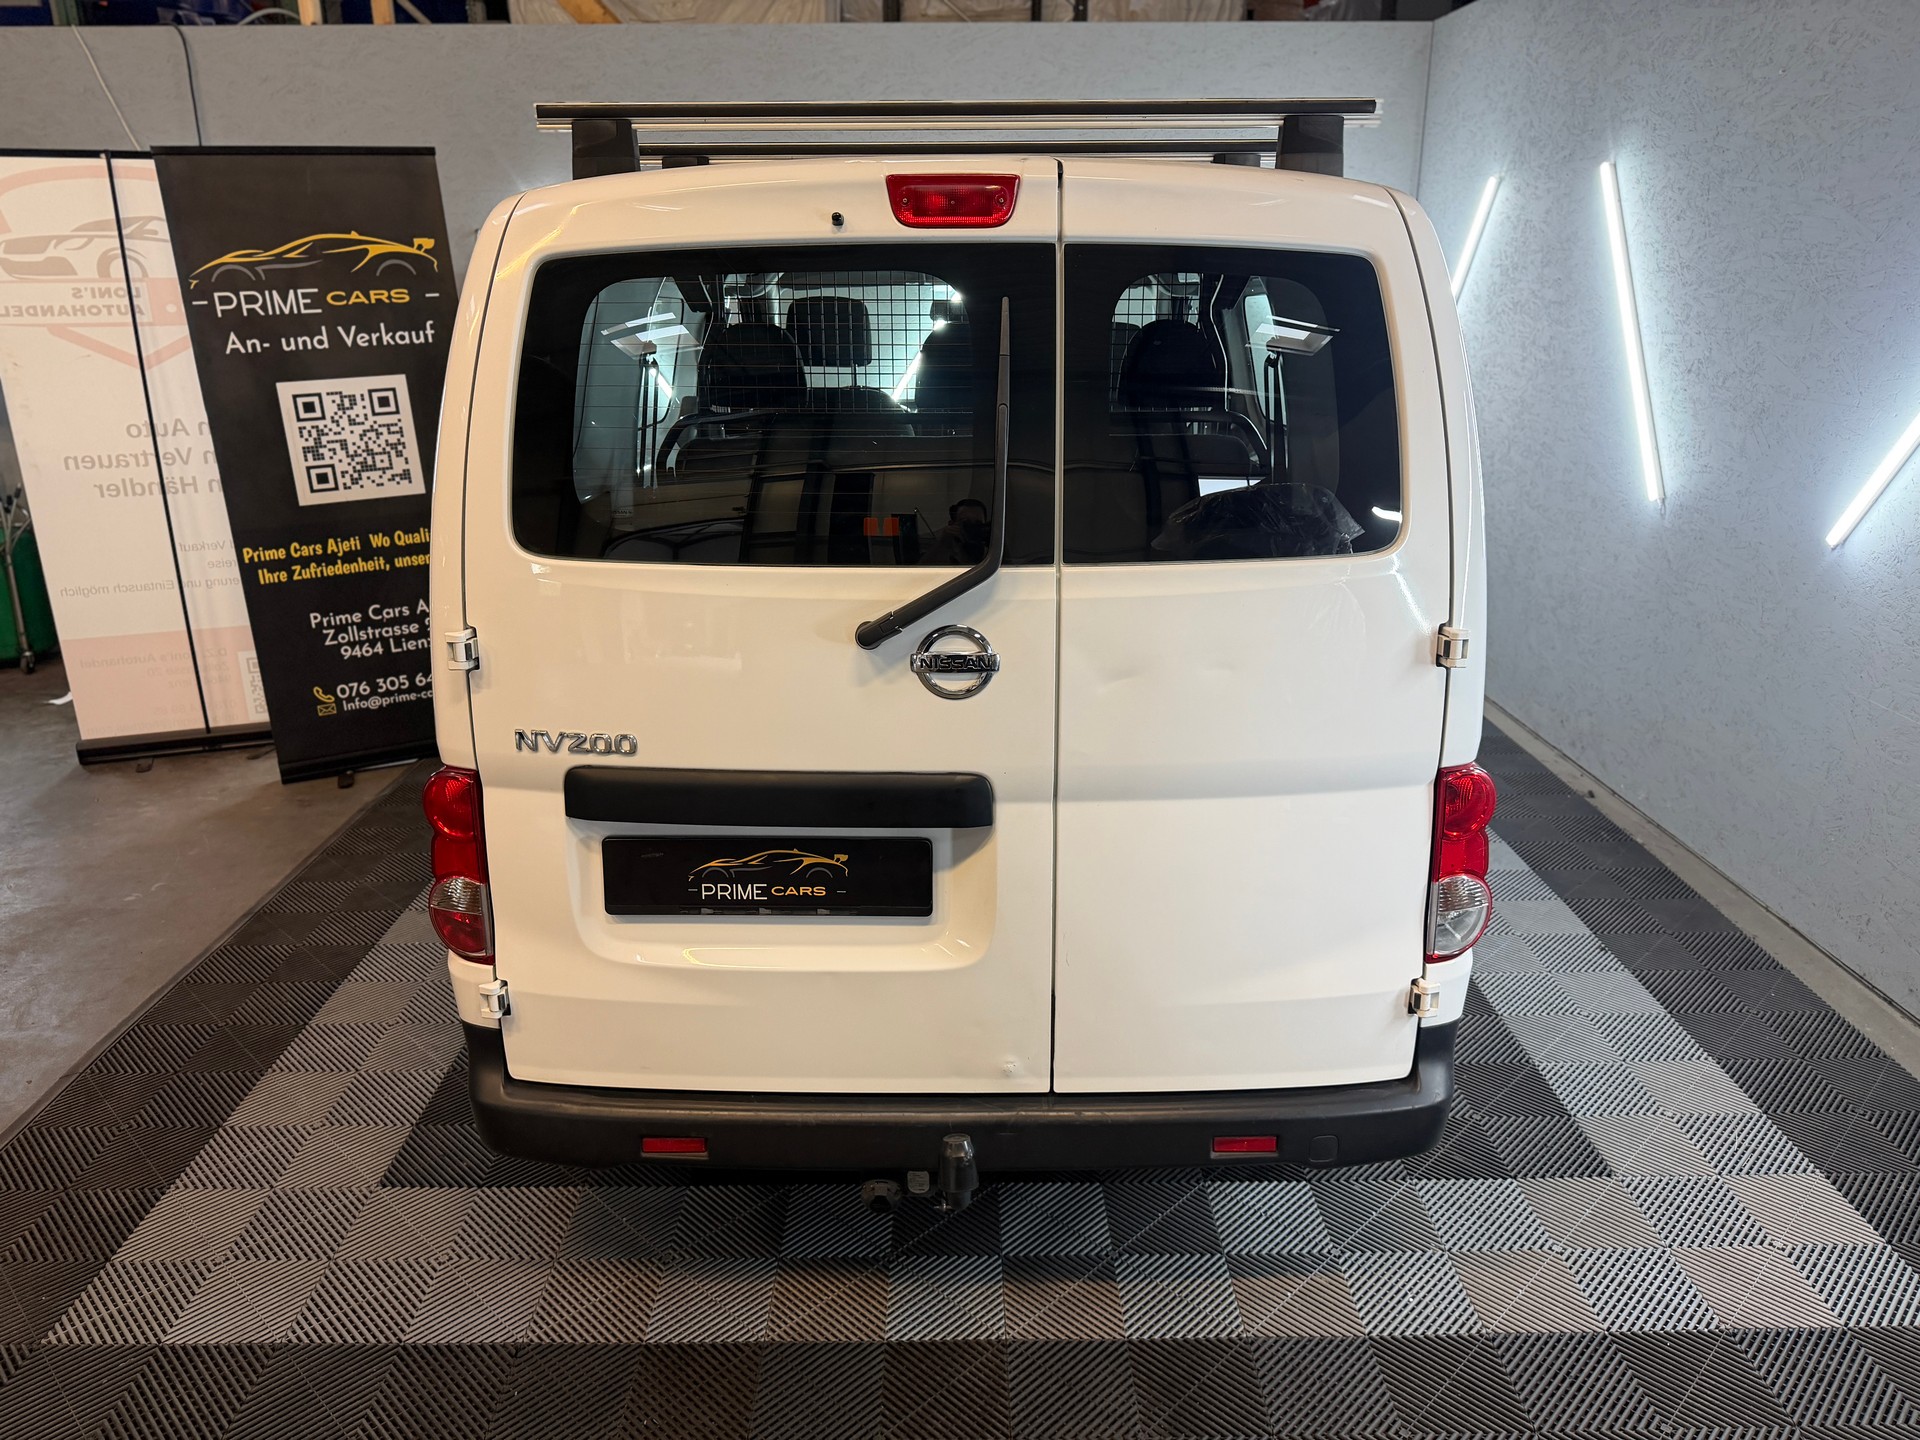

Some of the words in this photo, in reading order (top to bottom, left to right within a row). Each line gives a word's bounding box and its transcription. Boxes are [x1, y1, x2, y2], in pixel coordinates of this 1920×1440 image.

[213, 288, 323, 318] PRIME
[326, 288, 411, 306] CARS
[225, 331, 270, 354] An-
[281, 325, 329, 351] und
[337, 320, 436, 348] Verkauf
[242, 547, 287, 564] Prime
[290, 541, 323, 558] Cars
[326, 536, 361, 557] Ajeti
[368, 532, 391, 548] Wo
[258, 568, 288, 585] Ihre
[291, 556, 390, 582] Zufriedenheit,
[309, 612, 362, 629] Prime
[368, 604, 410, 621] Cars
[322, 622, 420, 646] Zollstrasse
[340, 641, 384, 660] 9464
[919, 656, 992, 670] NISSAN
[336, 681, 371, 699] 076
[376, 674, 409, 693] 305
[514, 728, 639, 755] NV200
[701, 883, 768, 900] PRIME
[771, 886, 827, 896] CARS
